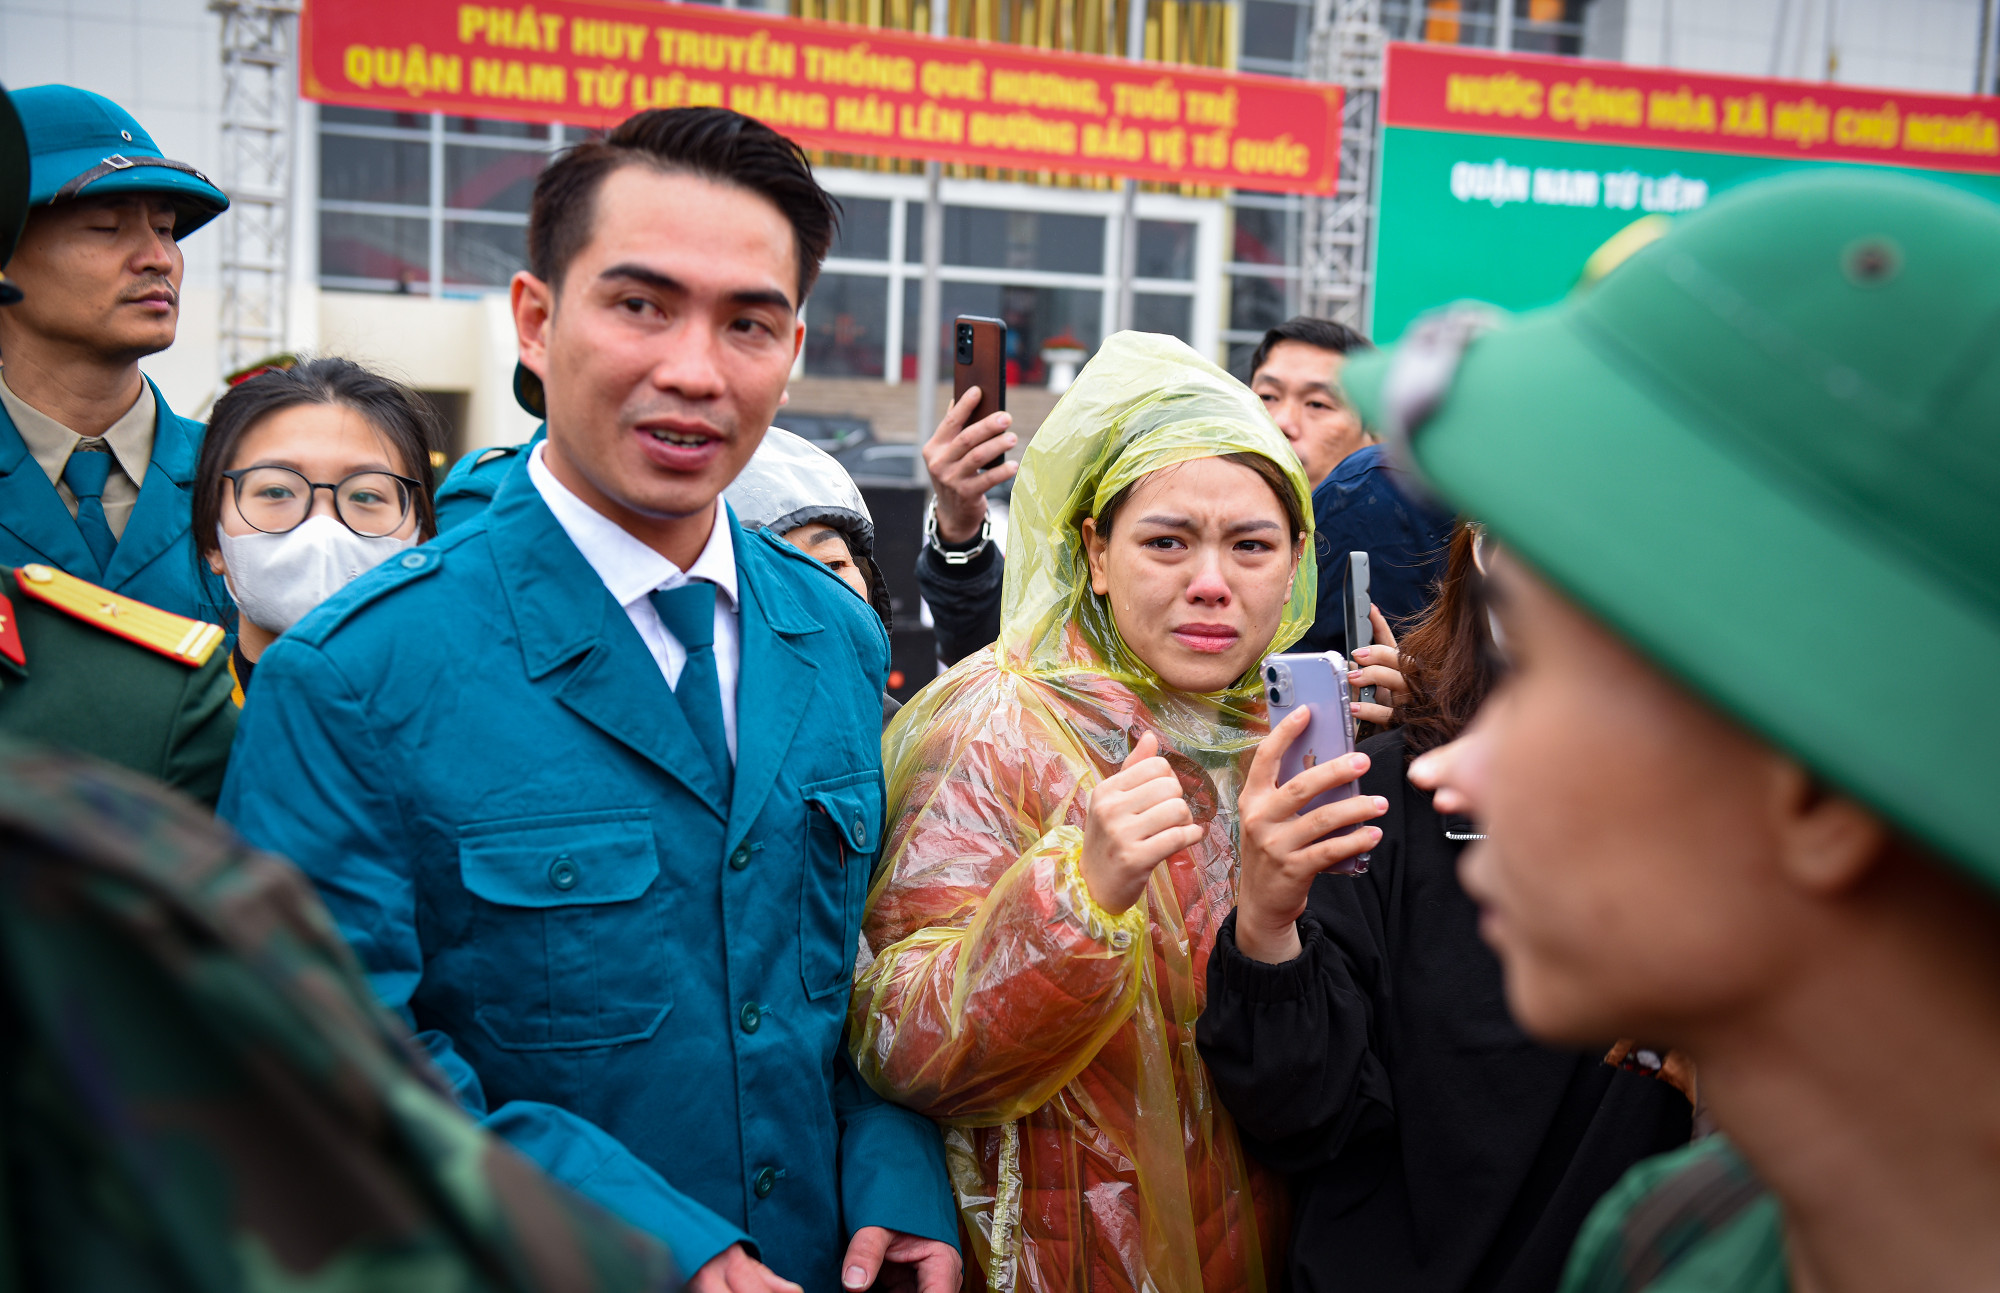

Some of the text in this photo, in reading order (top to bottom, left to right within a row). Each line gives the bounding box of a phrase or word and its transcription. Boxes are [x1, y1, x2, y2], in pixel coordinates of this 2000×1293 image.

[346, 44, 460, 95] QUẬN
[472, 59, 564, 101] NAM
[576, 66, 627, 108] TỪ
[633, 72, 721, 107] LIÊM
[836, 95, 893, 134] HÁI
[902, 103, 963, 142] LÊN
[460, 5, 563, 51] PHÁT
[573, 19, 647, 60] HUY
[803, 43, 913, 90] THỐNG
[922, 61, 985, 99] QUÊ
[1534, 169, 1597, 206] NAM
